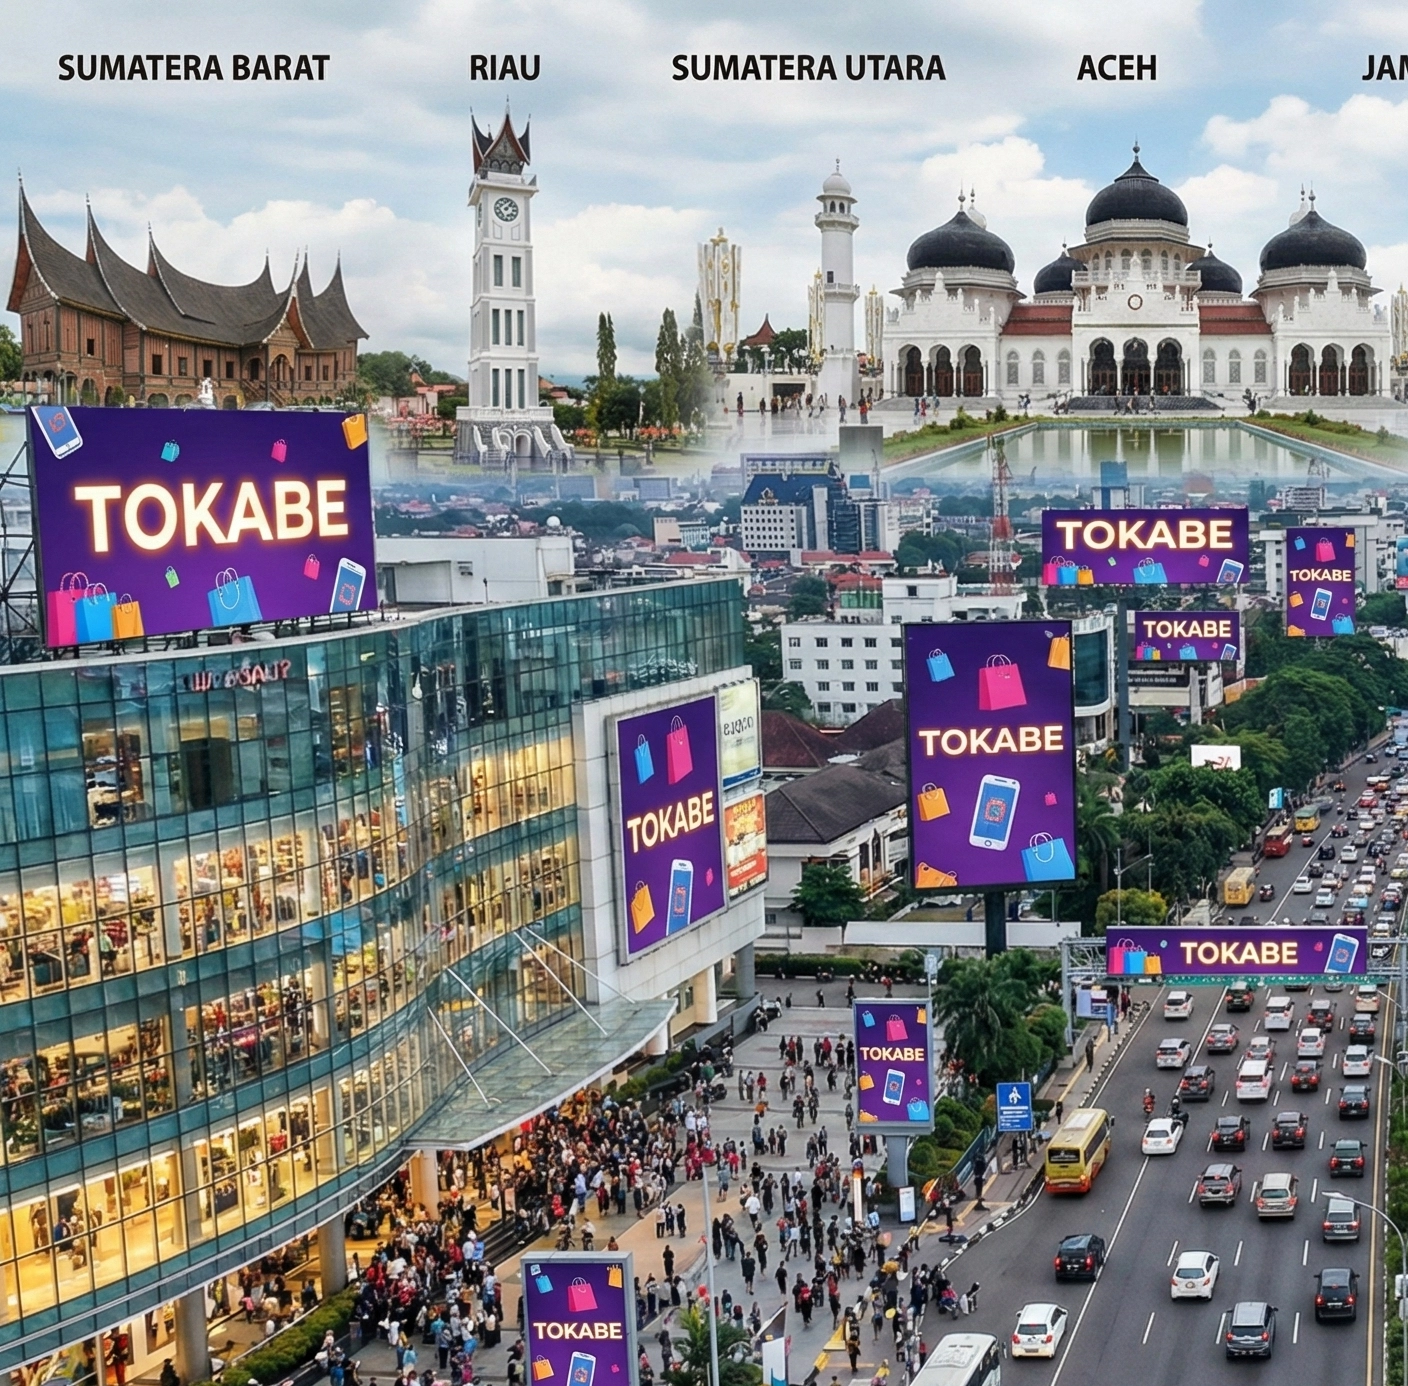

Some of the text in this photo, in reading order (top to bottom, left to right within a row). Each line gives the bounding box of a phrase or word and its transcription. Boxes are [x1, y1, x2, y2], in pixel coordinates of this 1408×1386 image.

[74, 479, 349, 553] TOKABE
[1056, 520, 1233, 550] TOKABE
[1289, 568, 1352, 582] TOKABE
[1143, 620, 1231, 638] TOKABE
[918, 725, 1064, 756] TOKABE
[627, 791, 715, 853] TOKABE
[1180, 941, 1298, 965] TOKABE
[860, 1046, 925, 1061] TOKABE
[533, 1322, 623, 1340] TOKABE
